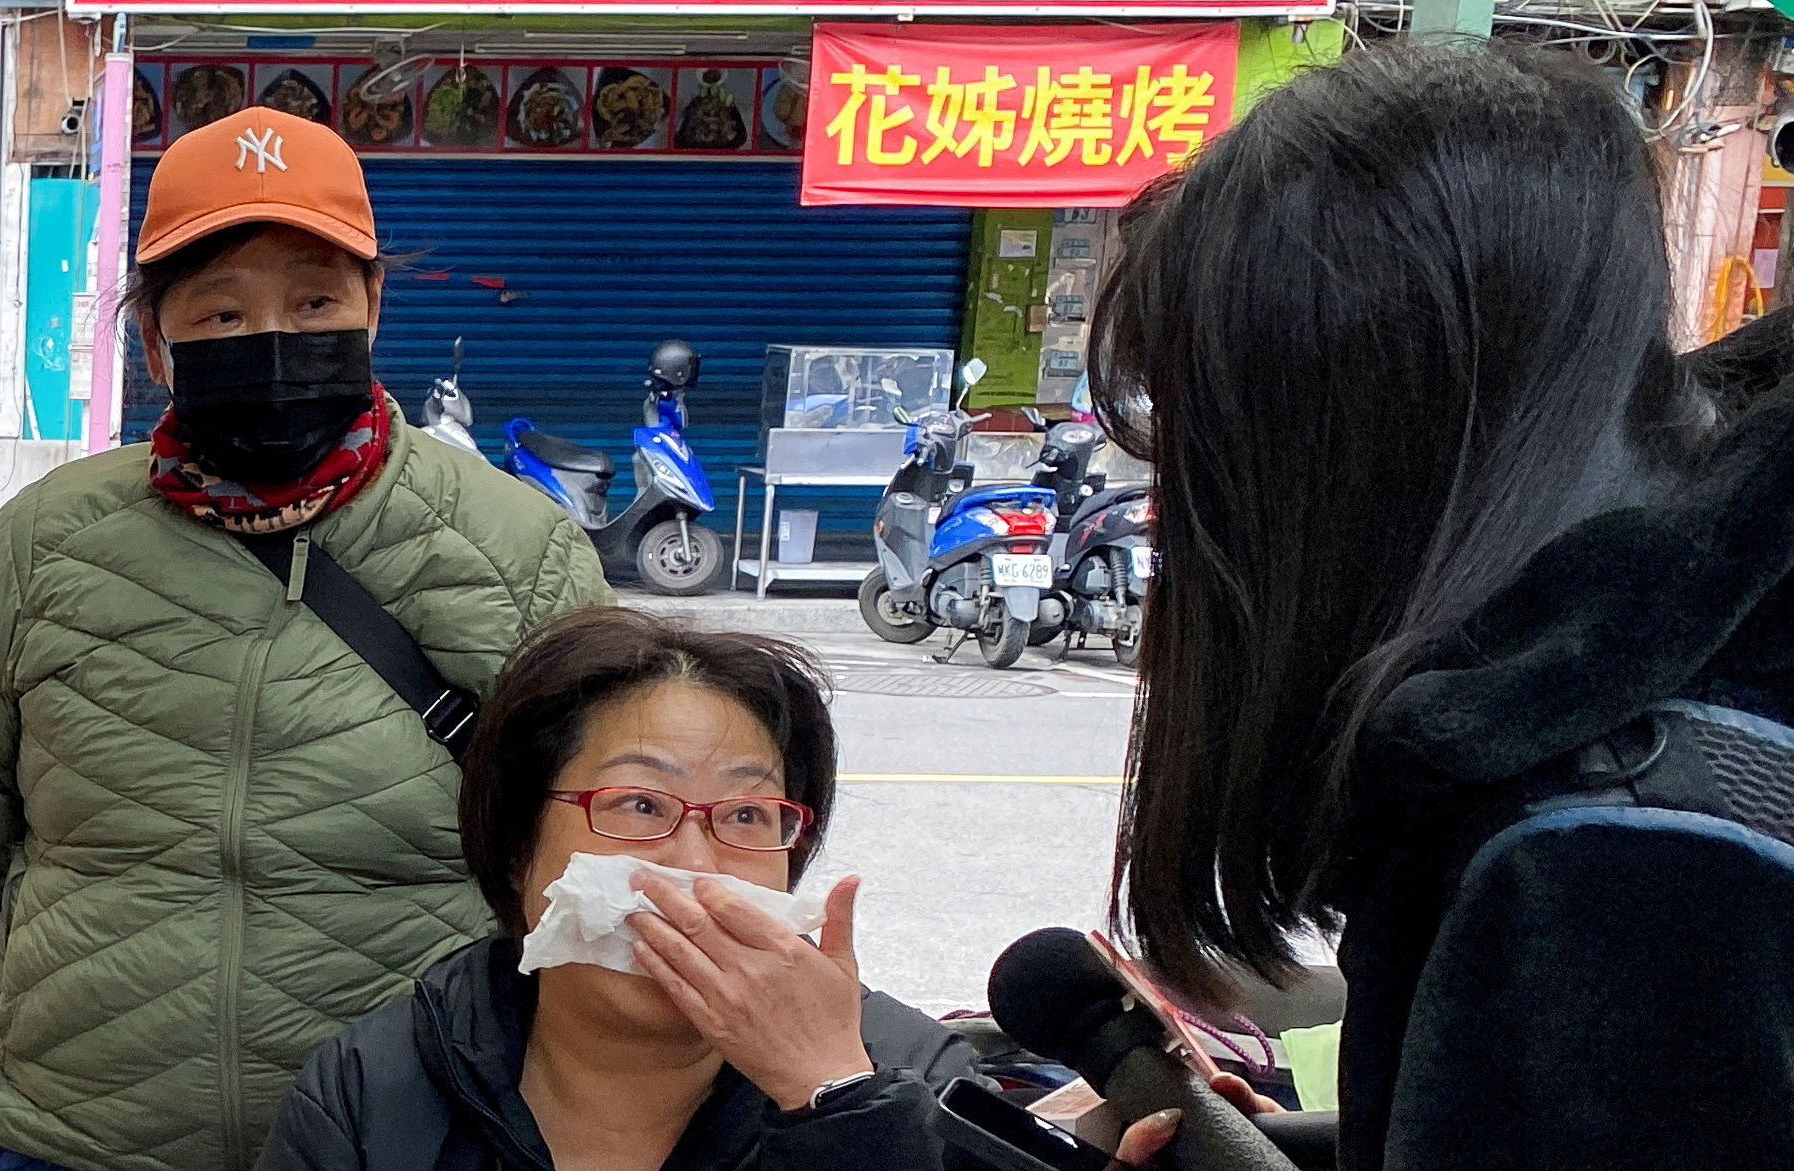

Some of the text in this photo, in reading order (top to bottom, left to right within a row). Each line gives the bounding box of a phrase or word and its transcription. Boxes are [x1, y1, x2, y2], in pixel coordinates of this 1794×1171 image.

[235, 127, 288, 173] NY
[826, 64, 1216, 167] 花姊燒烤
